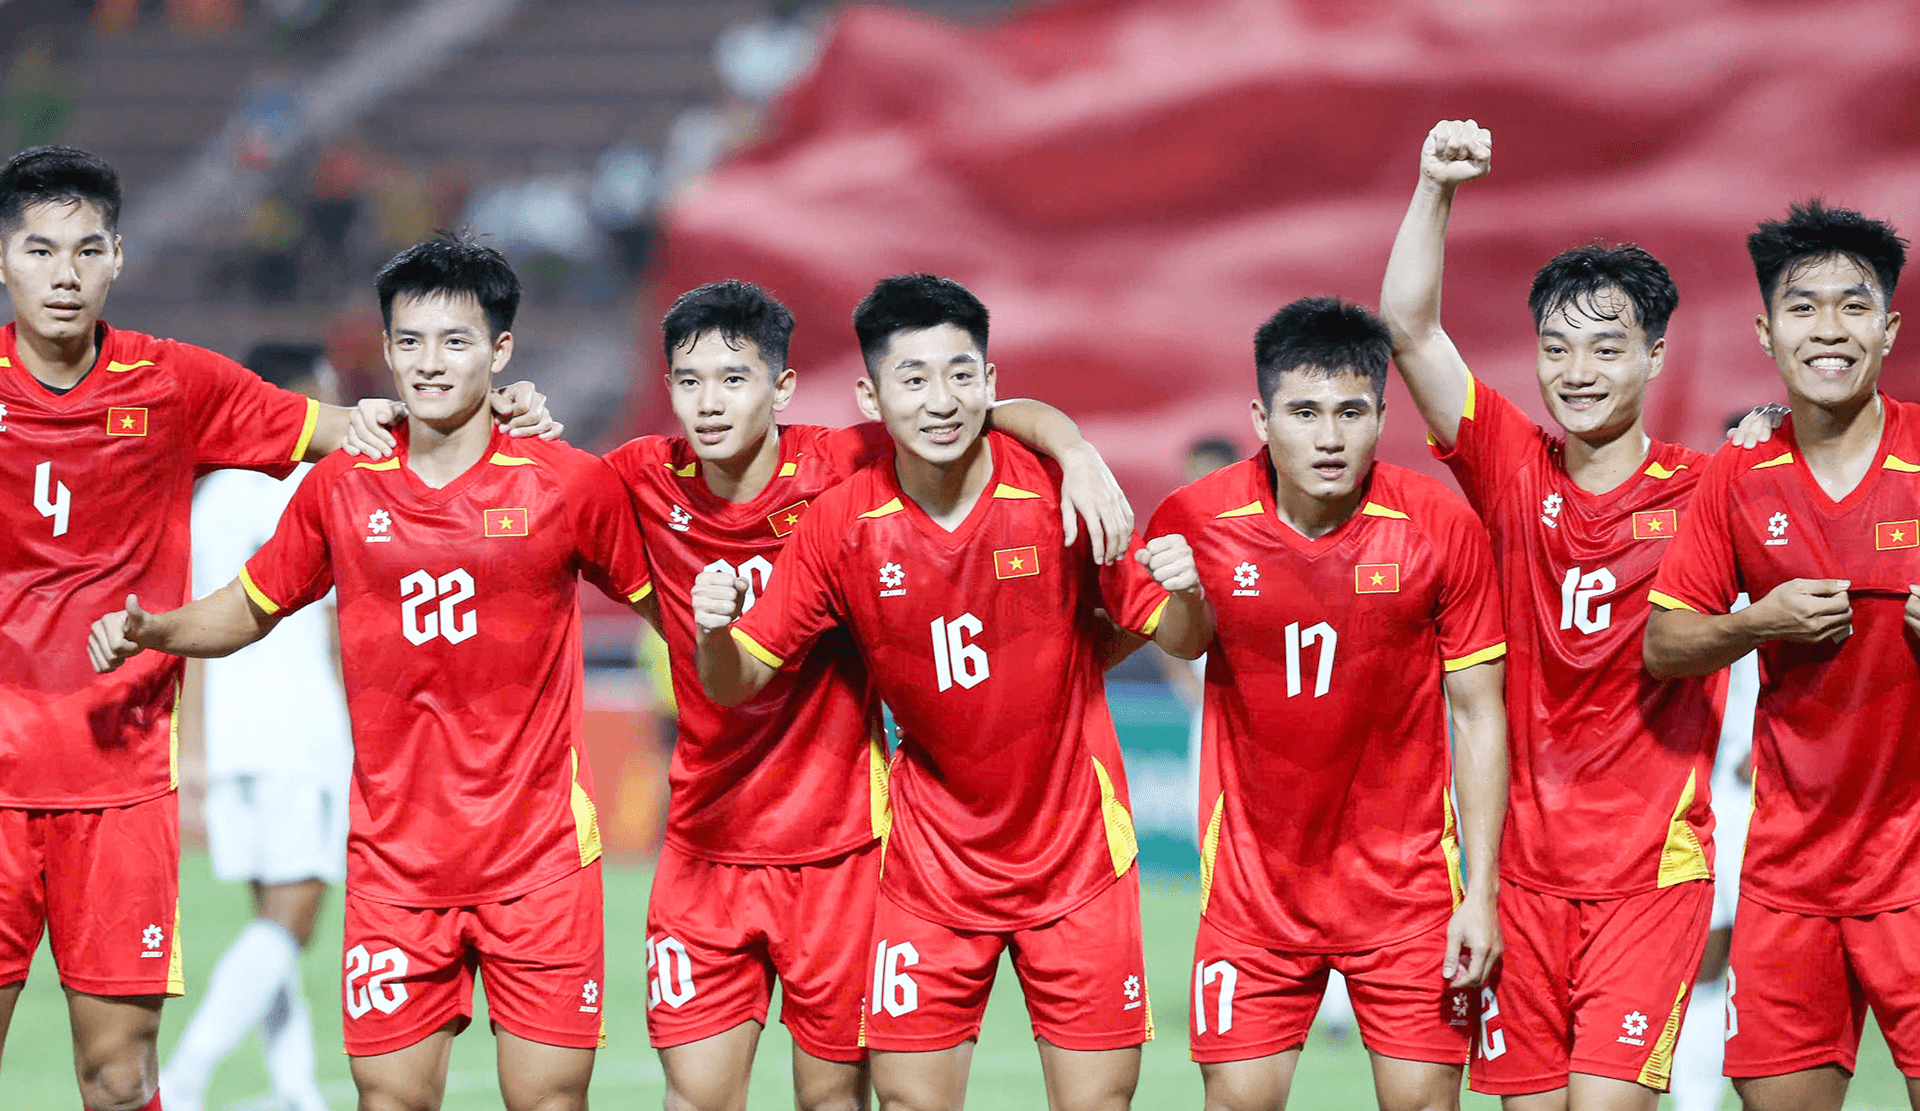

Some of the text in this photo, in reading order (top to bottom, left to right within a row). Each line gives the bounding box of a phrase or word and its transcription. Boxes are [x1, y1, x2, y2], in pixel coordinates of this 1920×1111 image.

[33, 460, 71, 537] 4
[399, 567, 478, 647] 22
[703, 554, 774, 617] 0
[1559, 566, 1617, 635] 12
[930, 612, 990, 693] 16
[1284, 621, 1338, 698] 17
[345, 943, 410, 1020] 22
[871, 938, 920, 1018] 16
[1194, 959, 1238, 1036] 17
